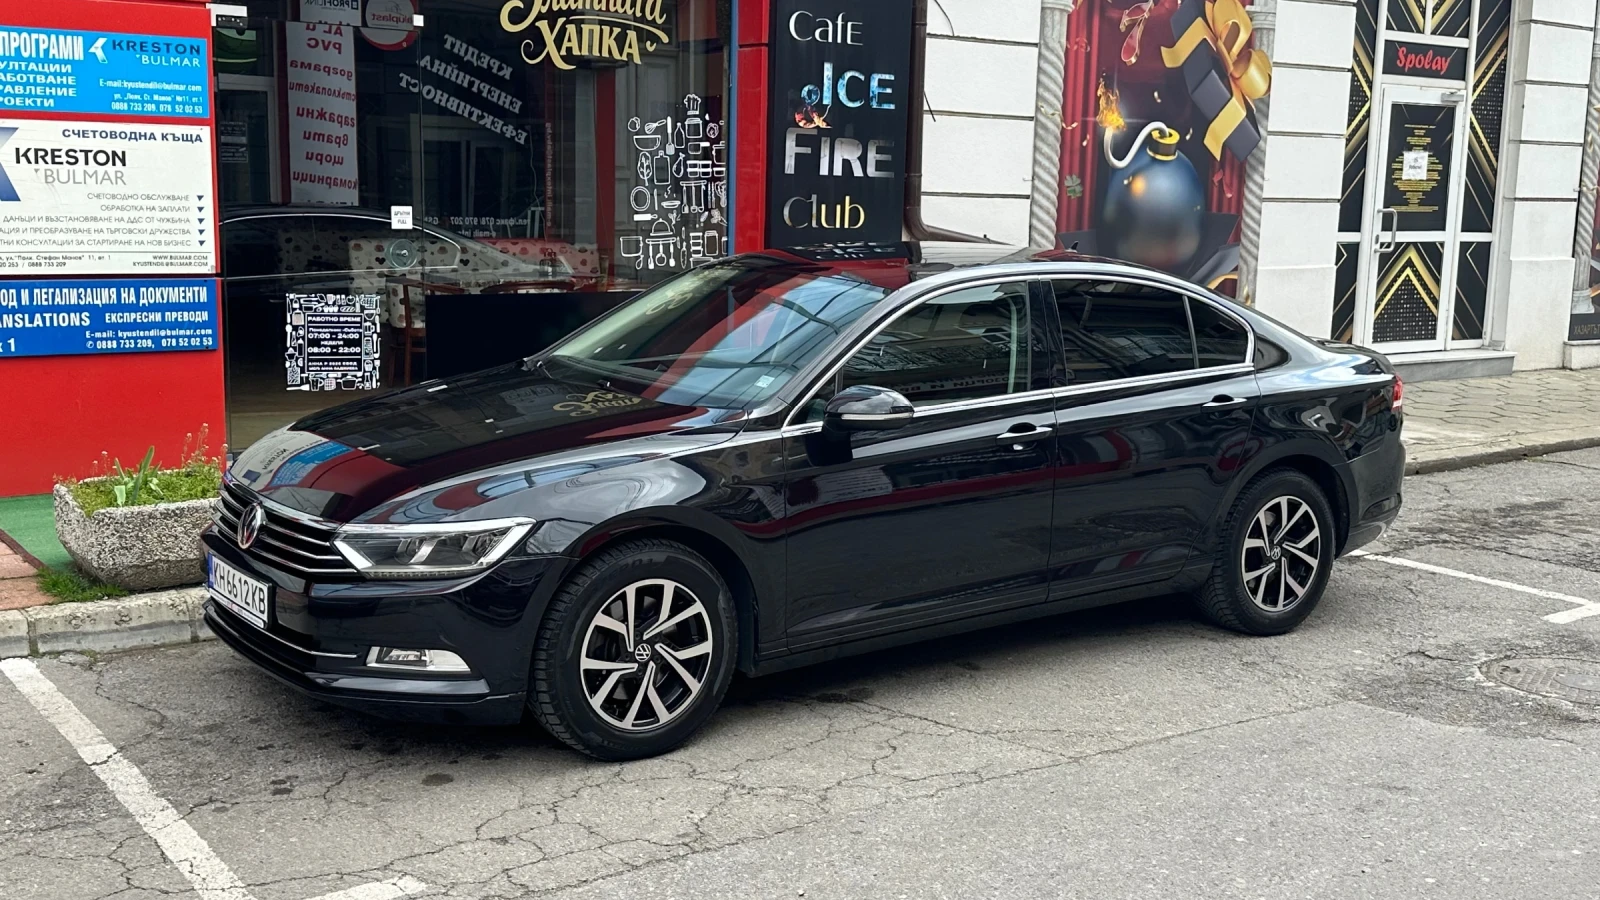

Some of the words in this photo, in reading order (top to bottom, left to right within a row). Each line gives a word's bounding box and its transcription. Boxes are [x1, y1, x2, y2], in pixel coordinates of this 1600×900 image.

[112, 39, 201, 55] KRESTON
[521, 17, 642, 70] ХАПКА
[141, 54, 201, 68] BULMAR
[1396, 46, 1451, 75] Spolay
[822, 61, 896, 110] ICE
[130, 102, 142, 111] 733
[175, 104, 183, 113] 52
[185, 105, 193, 113] 02
[194, 105, 203, 114] 53
[62, 128, 157, 142] СЧЕТОВОДНА
[161, 131, 203, 143] КЪЩА
[15, 147, 127, 167] KRESTON
[784, 127, 895, 178] FIRE
[44, 168, 127, 186] BULMAR
[87, 192, 139, 201] СЧЕТОВОДНО
[140, 194, 190, 202] ОБСЛУЖВАНЕ
[100, 204, 144, 212] ОБРАБОТКА
[158, 205, 191, 213] ЗАПЛАТИ
[783, 194, 865, 229] Club
[3, 215, 36, 223] ДАНЪЦИ
[45, 215, 113, 224] ВЪЗСТАНОВЯВАНЕ
[29, 227, 92, 235] ПРЕОБРАЗУВАНЕ
[16, 239, 73, 247] КОНСУЛТАЦИИ
[86, 239, 133, 247] СТАРТИРАНЕ
[134, 239, 146, 247] НА
[21, 288, 30, 306] И
[33, 287, 117, 307] ЛЕГАЛИЗАЦИЯ
[121, 287, 137, 304] НА
[139, 286, 208, 307] ДОКУМЕНТИ
[105, 311, 162, 323] ЕКСПРЕСНИ
[165, 311, 209, 322] ПРЕВОДИ
[85, 330, 116, 339] E-mail:
[118, 328, 213, 339] kyustendil@bulmar.com
[96, 340, 117, 349] 0888
[120, 339, 135, 348] 733
[137, 339, 155, 349] 209,
[161, 338, 177, 347] 078
[178, 338, 189, 346] 52
[191, 338, 201, 346] 02
[203, 337, 213, 346] 53
